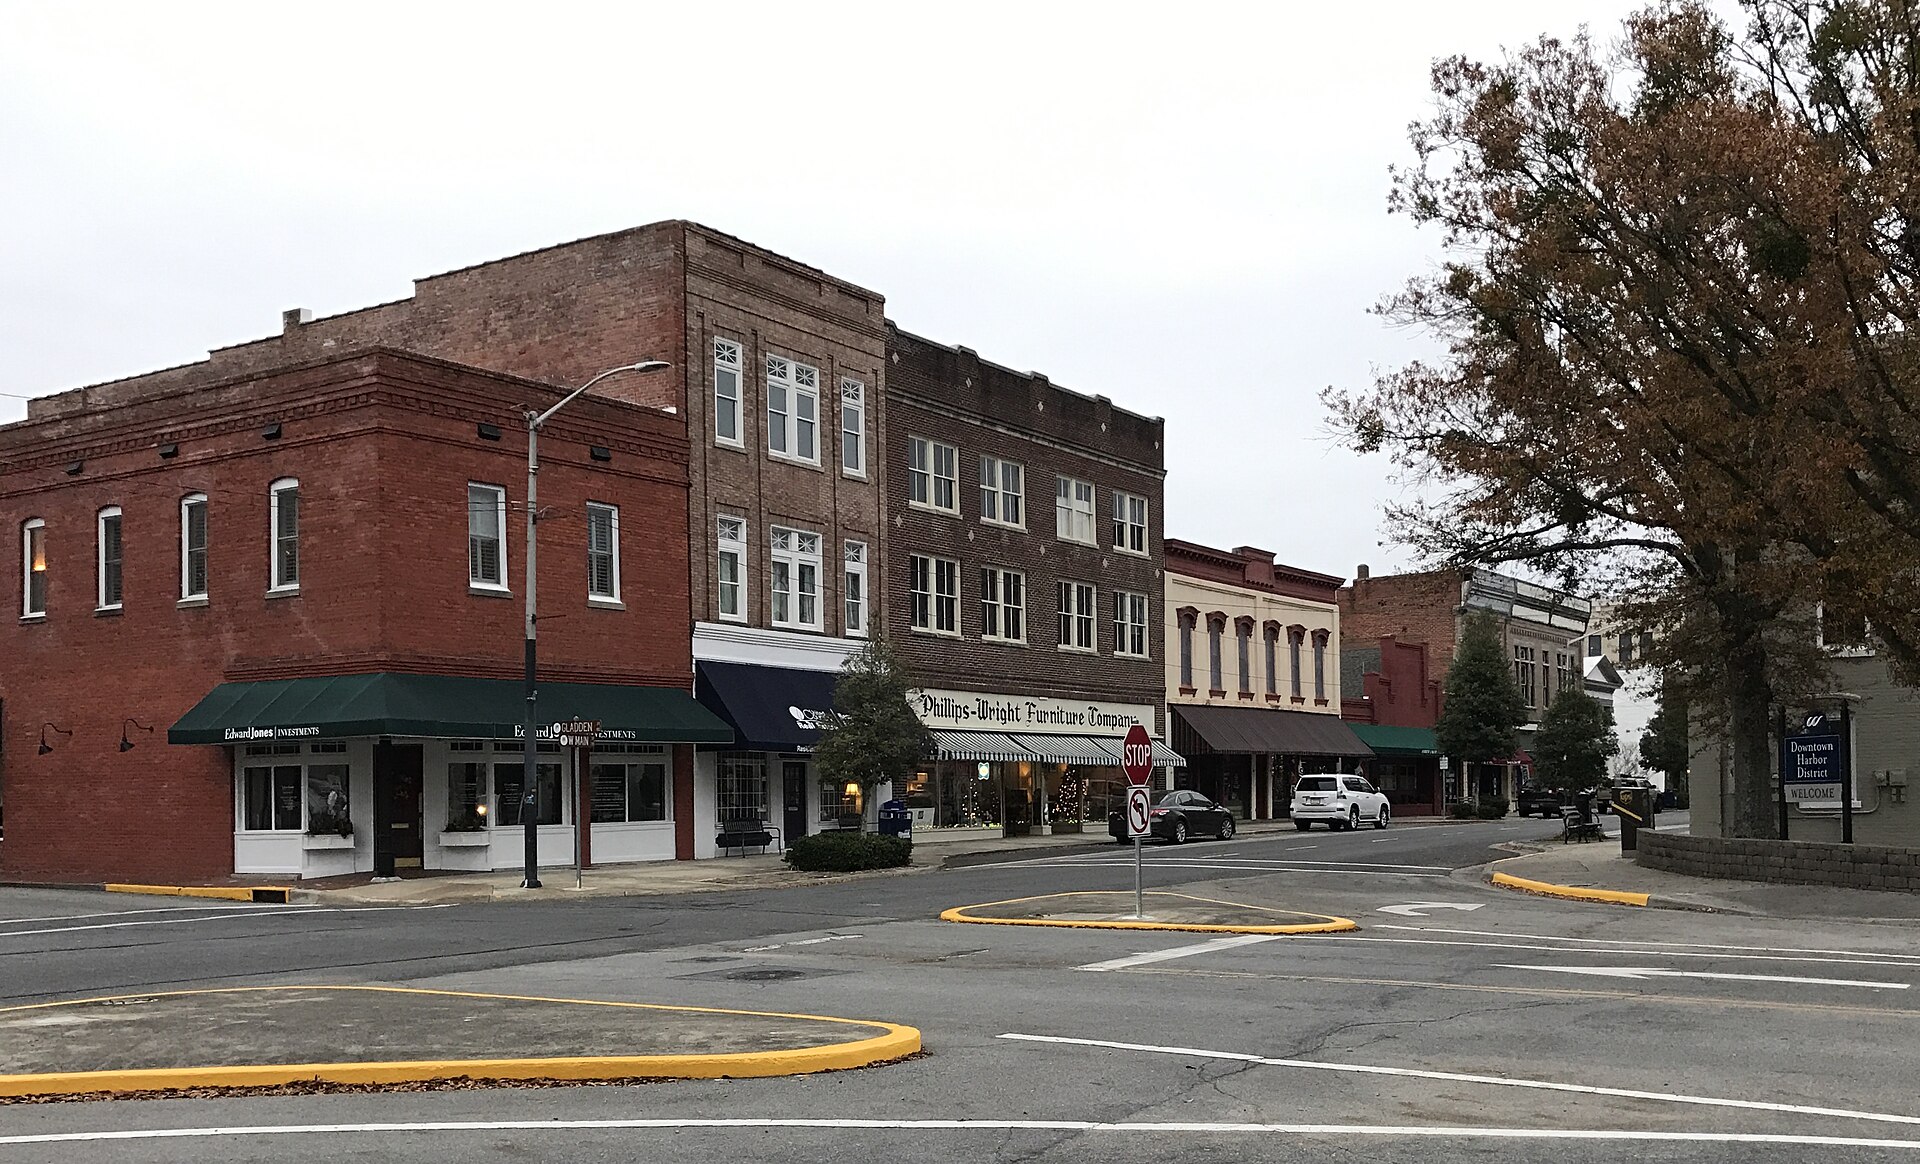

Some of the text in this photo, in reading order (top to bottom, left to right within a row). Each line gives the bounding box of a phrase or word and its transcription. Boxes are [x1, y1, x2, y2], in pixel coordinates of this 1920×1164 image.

[920, 694, 1021, 725] Phillips-Wright
[1025, 702, 1085, 727] Furniture
[277, 727, 320, 737] INVESTMENTS
[561, 722, 593, 733] GLADDEN
[574, 735, 589, 746] MAIN
[1791, 741, 1834, 753] Downtown
[1125, 743, 1151, 767] STOP
[1797, 753, 1828, 765] Harbor
[1797, 766, 1828, 778] District
[1791, 788, 1835, 799] WELCOME
